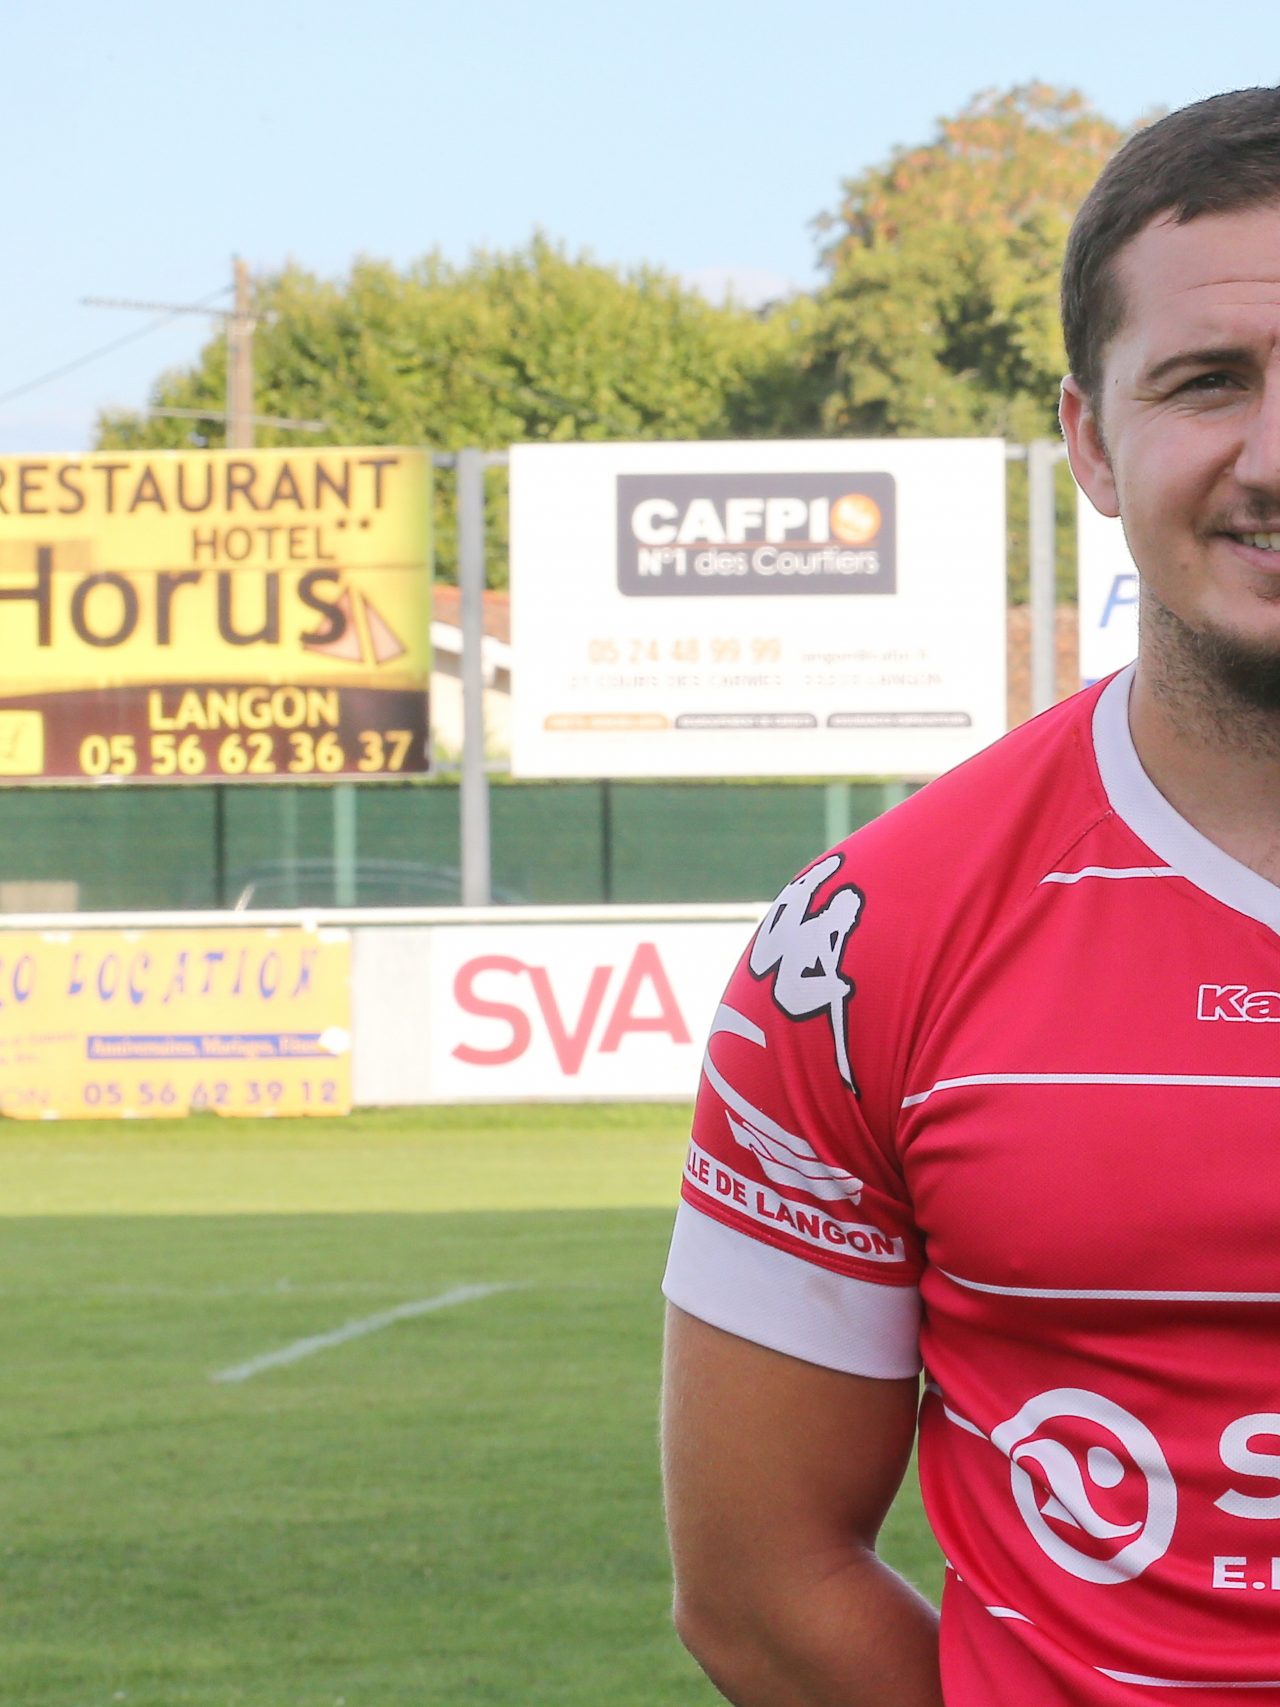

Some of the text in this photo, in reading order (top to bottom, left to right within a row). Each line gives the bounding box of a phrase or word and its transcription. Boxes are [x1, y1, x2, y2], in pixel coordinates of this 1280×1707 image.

[0, 459, 398, 515] ESTAURANT
[631, 497, 829, 544] CAFPI
[192, 526, 335, 562] HOTEL
[694, 547, 749, 576] des
[751, 546, 880, 576] Courtiers
[0, 545, 348, 647] Horus
[148, 688, 340, 730] LANGON
[80, 730, 413, 776] 05 56 62 36 37
[450, 942, 693, 1076] SVA
[84, 1080, 336, 1107] 05 56 62 39 12
[716, 1168, 748, 1207] DE
[756, 1191, 895, 1254] LANGON
